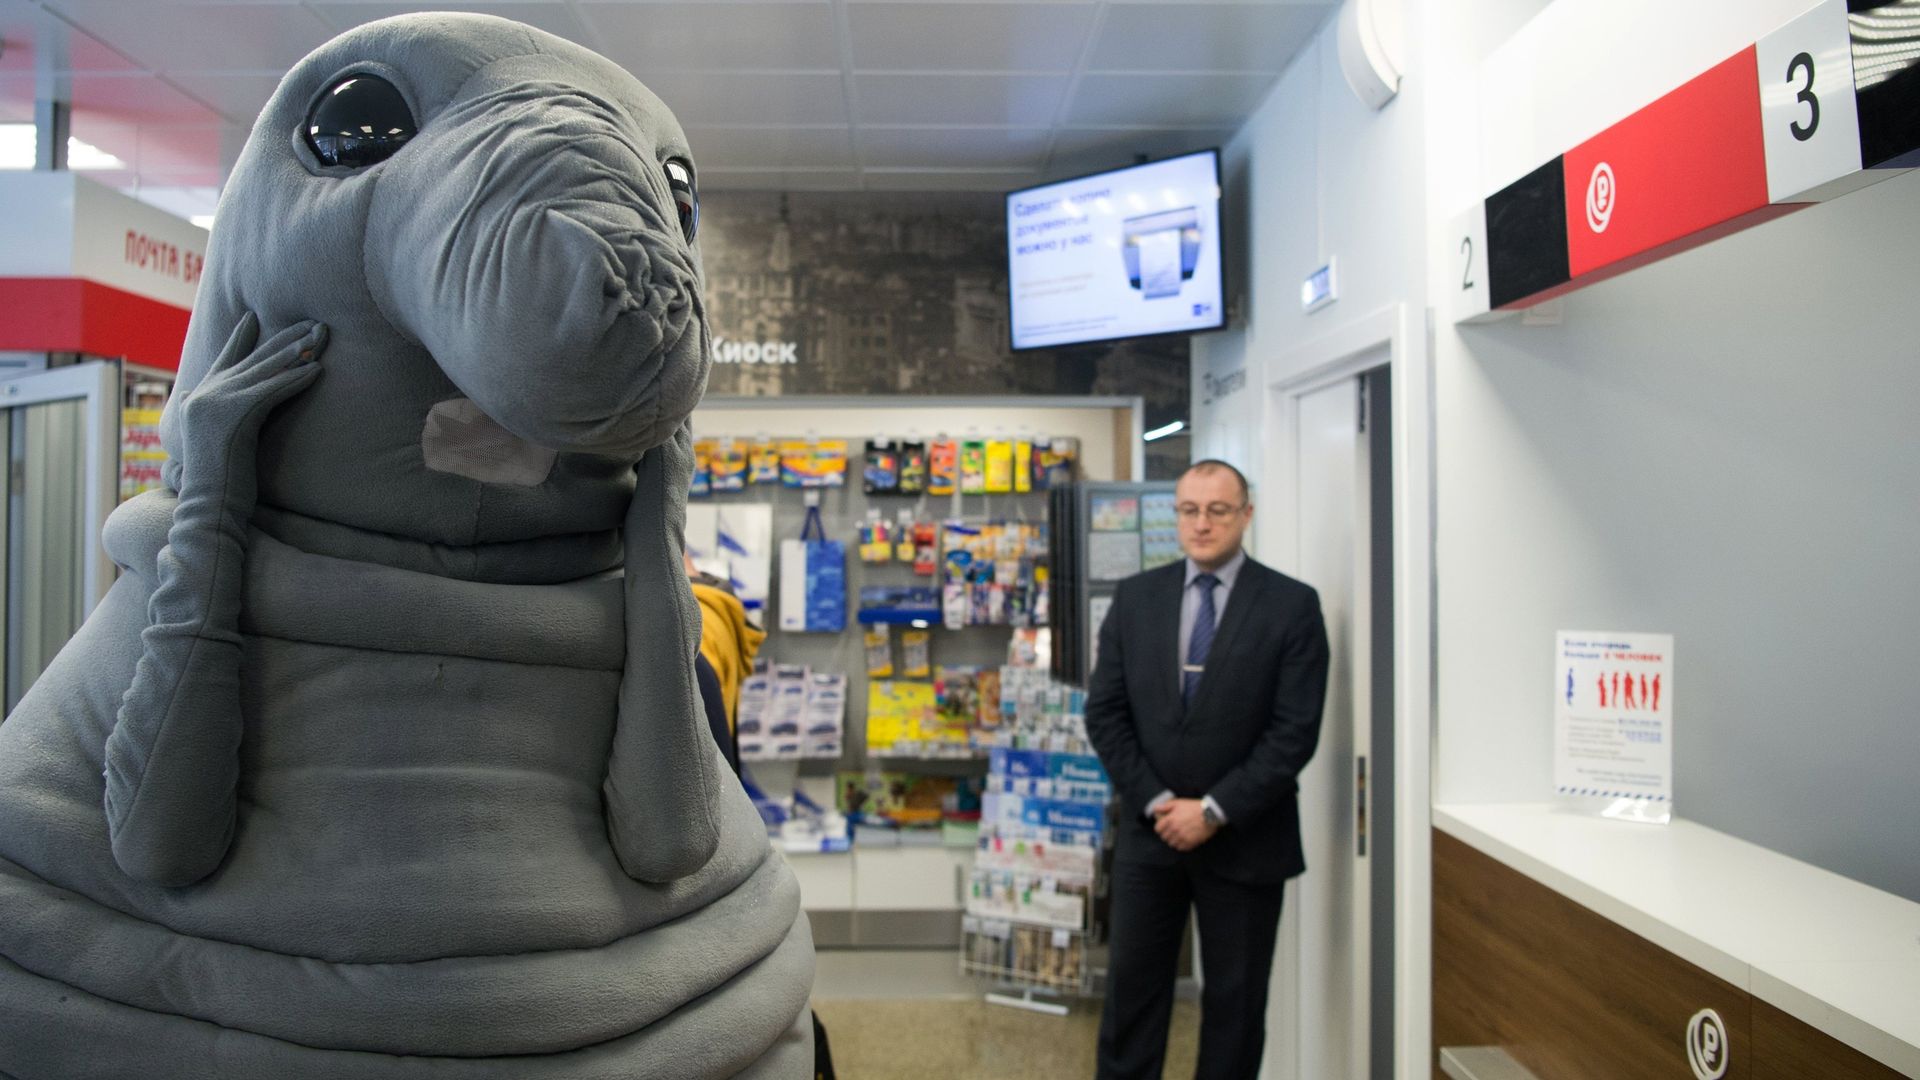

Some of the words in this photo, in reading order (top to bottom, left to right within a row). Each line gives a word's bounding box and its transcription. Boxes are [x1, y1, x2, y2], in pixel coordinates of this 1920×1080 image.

[1786, 51, 1820, 142] 3
[124, 229, 179, 279] ПОЧТА
[1460, 235, 1474, 291] 2
[712, 336, 798, 364] Киоск
